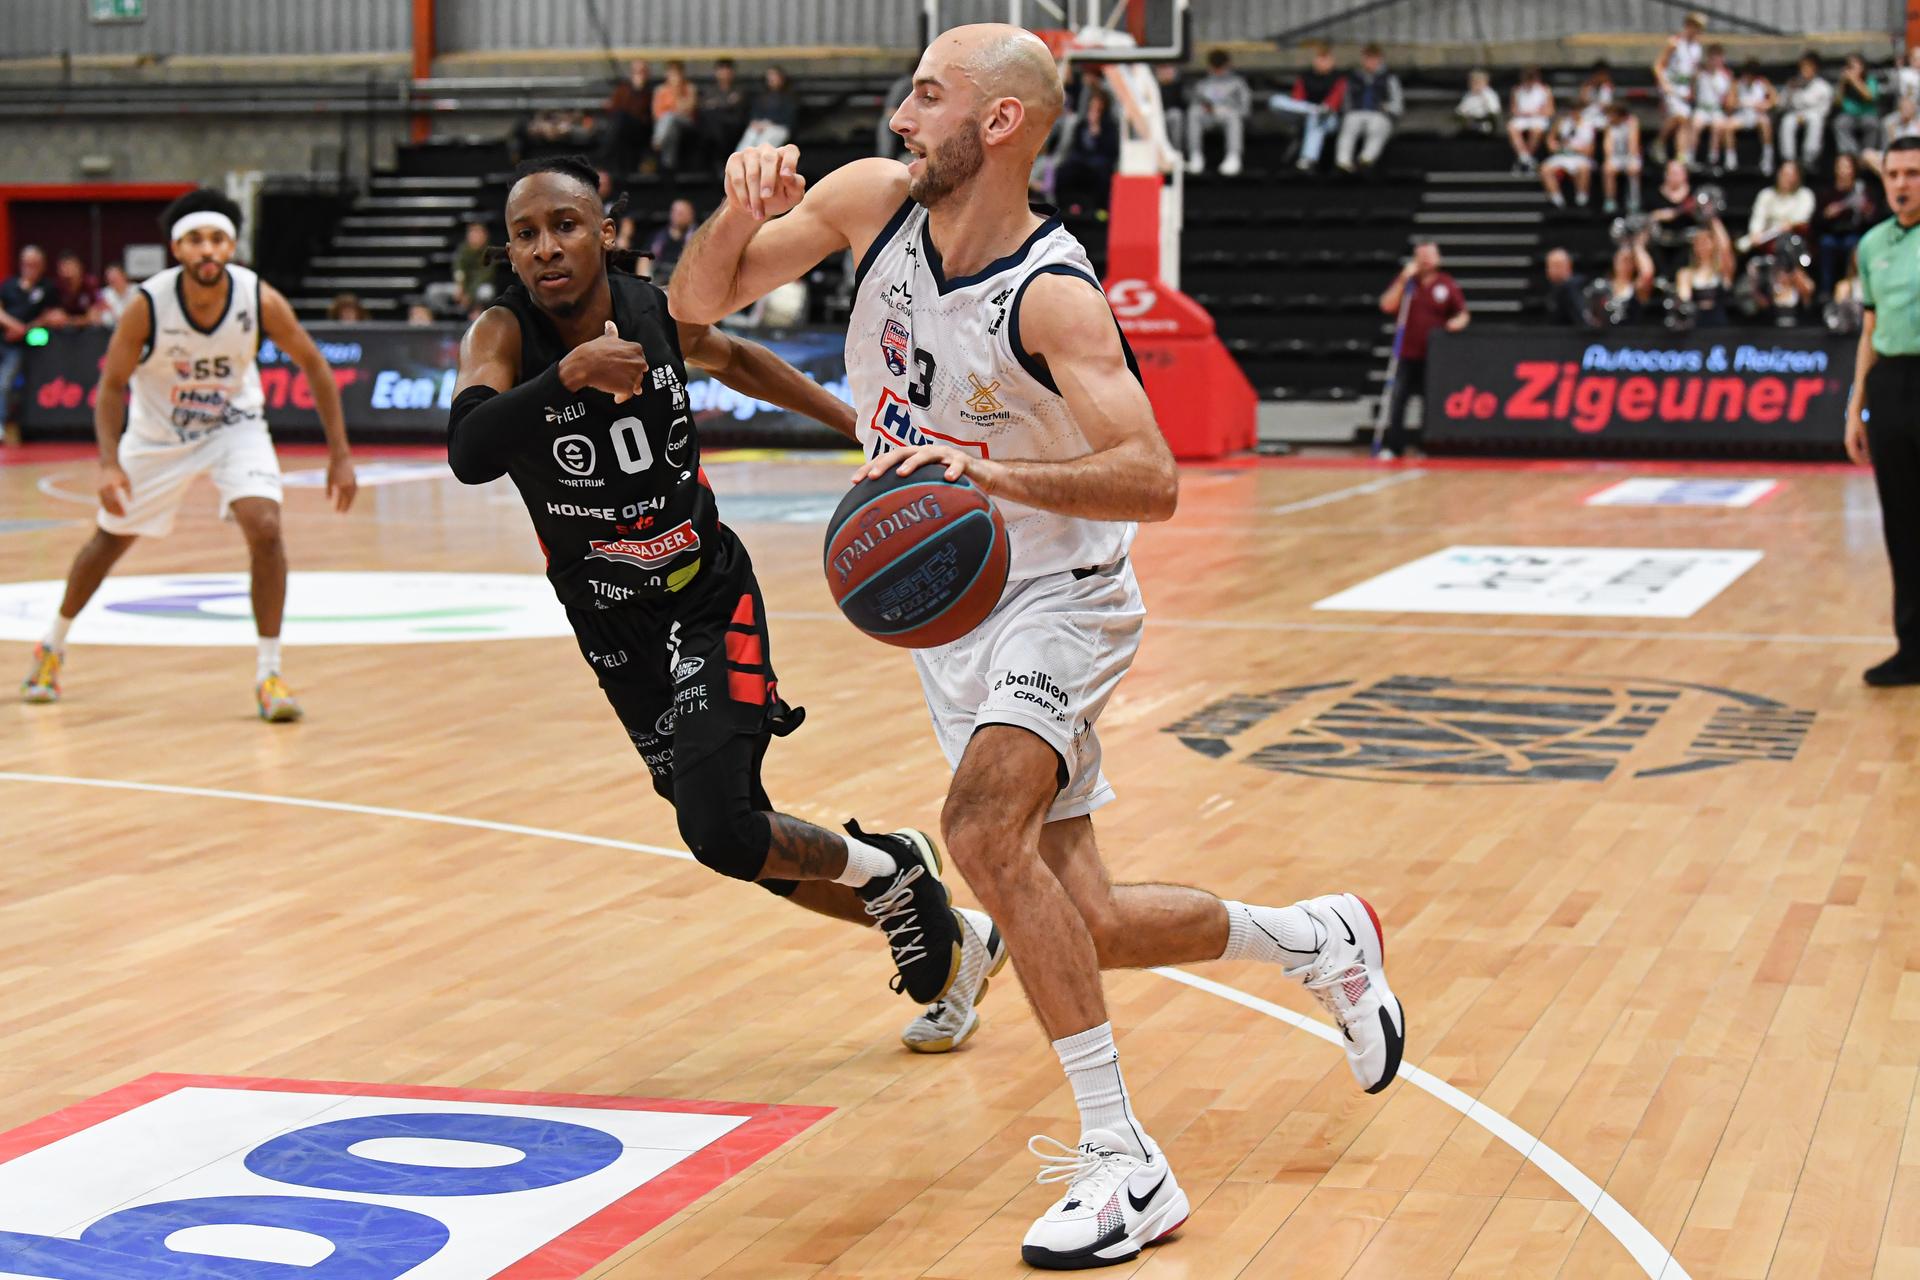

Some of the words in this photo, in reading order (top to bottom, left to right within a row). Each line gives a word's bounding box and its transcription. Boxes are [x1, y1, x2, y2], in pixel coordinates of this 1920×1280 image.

[195, 356, 231, 380] 55
[1582, 345, 1702, 372] Autocars
[1706, 345, 1728, 372] &
[1734, 345, 1829, 373] Reizen
[37, 376, 83, 409] de
[908, 348, 937, 409] 3
[1445, 386, 1497, 418] de
[1504, 361, 1824, 433] Zigeuner
[960, 410, 1010, 421] PepperMill
[609, 416, 654, 474] 0
[546, 502, 617, 521] HOUSE
[622, 500, 650, 519] OF
[833, 494, 944, 585] SPALDING
[1005, 670, 1069, 707] baillien
[1013, 690, 1058, 714] CRAFT
